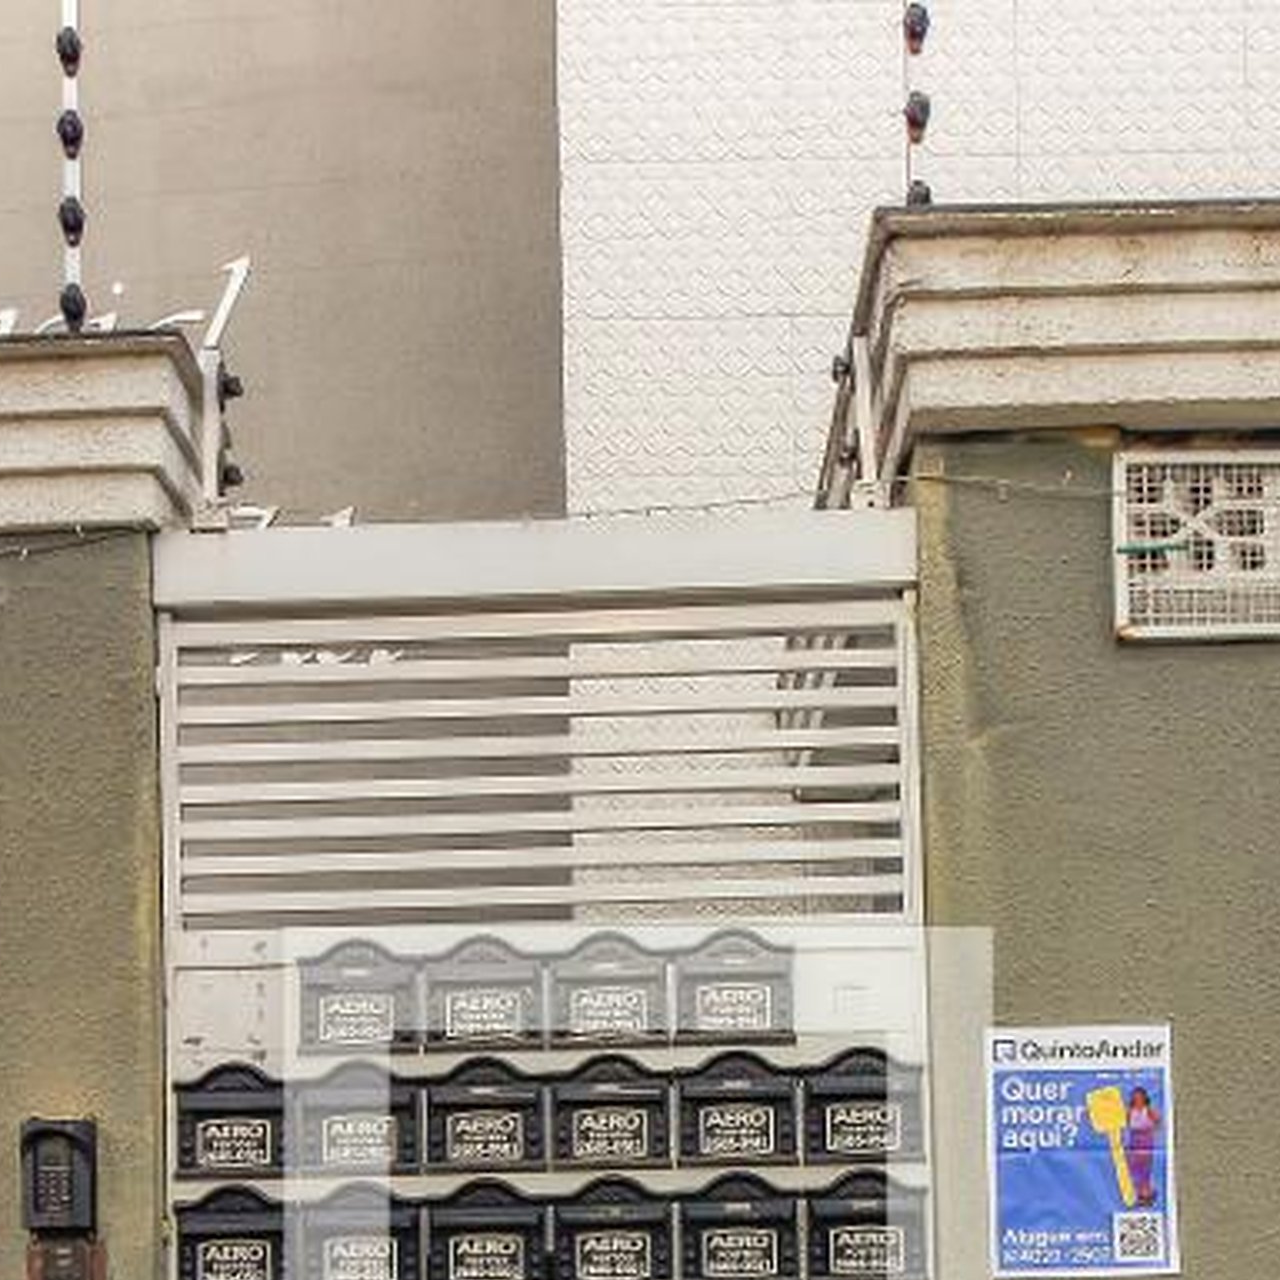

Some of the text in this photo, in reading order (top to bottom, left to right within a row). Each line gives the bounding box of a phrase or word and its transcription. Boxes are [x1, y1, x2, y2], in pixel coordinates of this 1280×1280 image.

[1020, 1039, 1164, 1061] QuintoAndar
[1001, 1076, 1076, 1101] Quer
[1001, 1104, 1086, 1124] morar
[1001, 1124, 1079, 1153] aqui?
